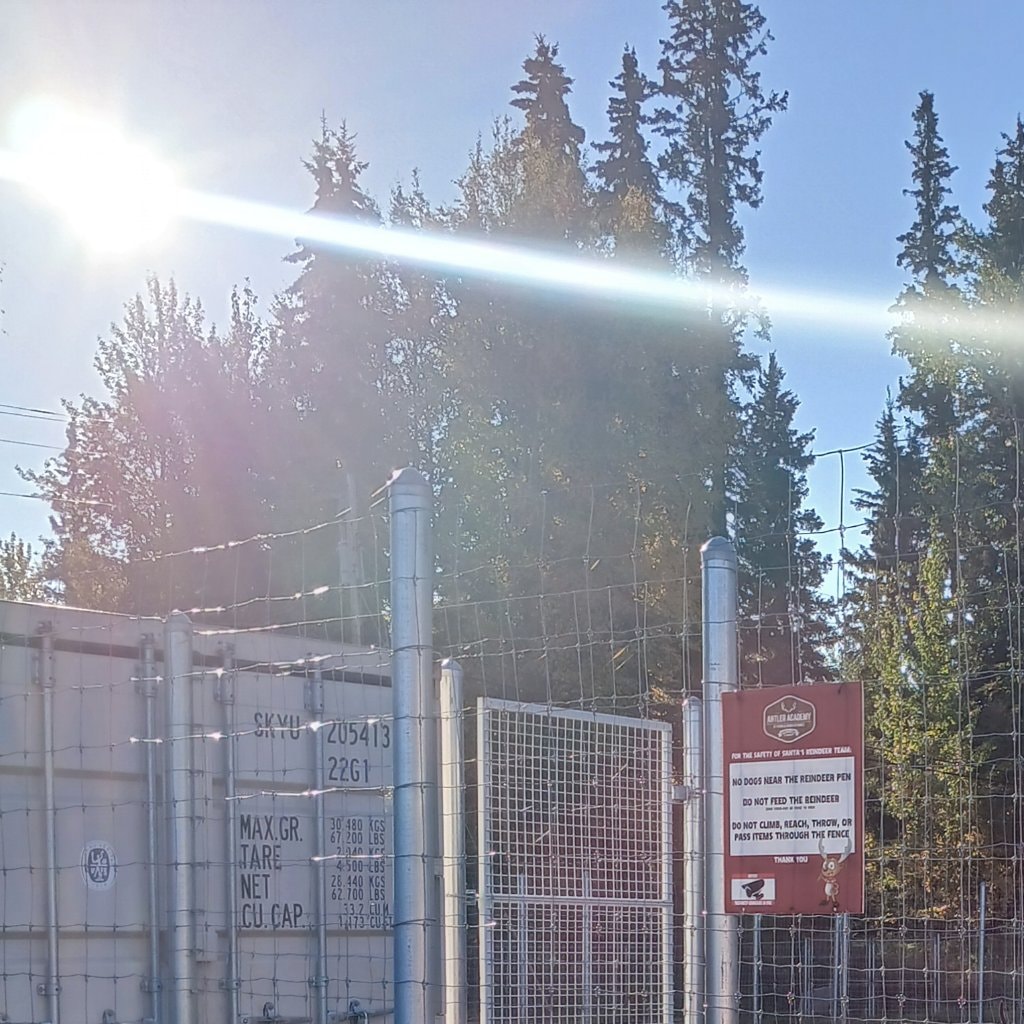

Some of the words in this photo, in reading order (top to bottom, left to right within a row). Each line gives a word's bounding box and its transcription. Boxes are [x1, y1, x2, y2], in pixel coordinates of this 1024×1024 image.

[254, 712, 300, 740] SKYU
[327, 718, 390, 748] 205413
[782, 748, 804, 756] SANTA'S
[328, 756, 369, 783] 22G1
[732, 778, 742, 786] NO
[744, 777, 762, 786] DOGS
[764, 776, 782, 784] NEAR
[784, 776, 798, 784] THE
[800, 774, 834, 782] REINDEER
[836, 772, 852, 781] PEN
[742, 798, 752, 806] DO
[754, 798, 768, 806] NOT
[770, 796, 787, 805] FEED
[789, 796, 802, 804] THE
[805, 794, 840, 804] REINDEER
[368, 820, 386, 832] KGS
[732, 822, 741, 830] DO
[743, 821, 758, 830] NOT
[760, 820, 782, 830] CLIMB,
[784, 820, 810, 829] REACH,
[812, 819, 840, 828] THROW,
[842, 818, 852, 826] OR
[368, 833, 385, 846] LBS
[734, 832, 750, 841] PASS
[752, 832, 774, 840] ITEMS
[775, 831, 810, 840] THROUGH
[812, 830, 826, 839] THE
[828, 830, 850, 838] FENCE
[240, 844, 282, 870] TARE
[336, 847, 363, 860] 2040
[368, 847, 386, 860] KGS
[368, 860, 386, 874] LBS
[241, 874, 270, 899] NET
[368, 876, 386, 888] KGS
[369, 888, 386, 900] LBS
[339, 916, 364, 928] 1173
